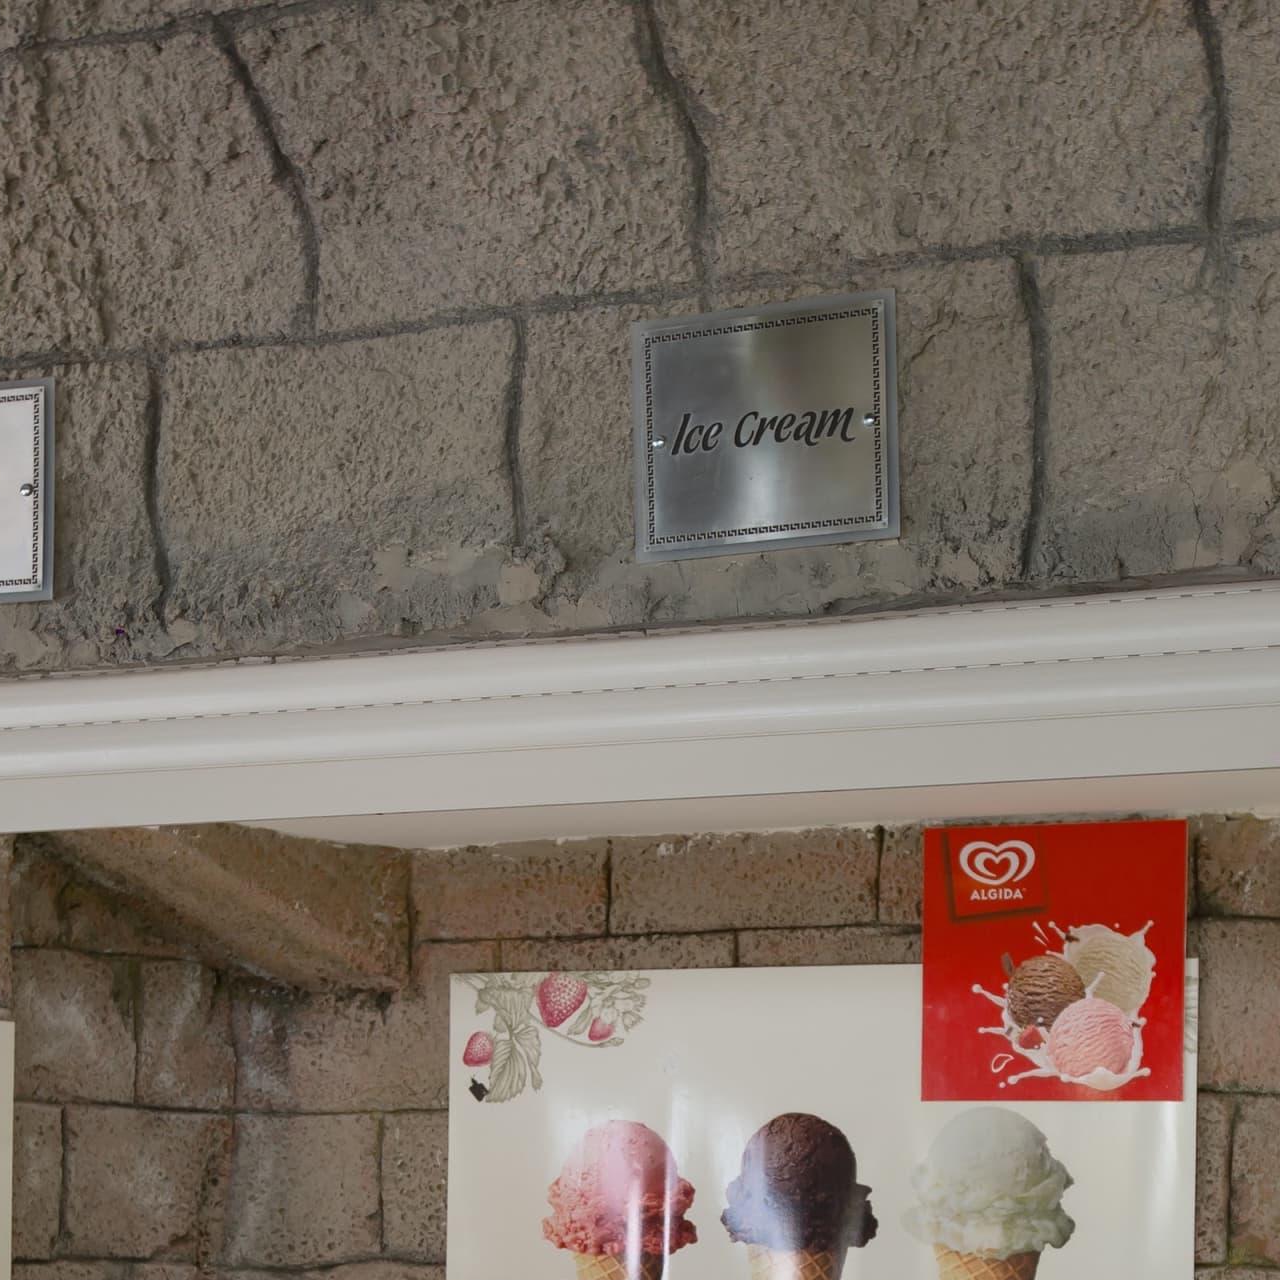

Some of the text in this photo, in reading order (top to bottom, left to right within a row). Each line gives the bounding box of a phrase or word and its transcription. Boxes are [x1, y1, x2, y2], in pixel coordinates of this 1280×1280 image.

[671, 407, 856, 456] Ice Cream
[970, 888, 1023, 901] ALGIDA
